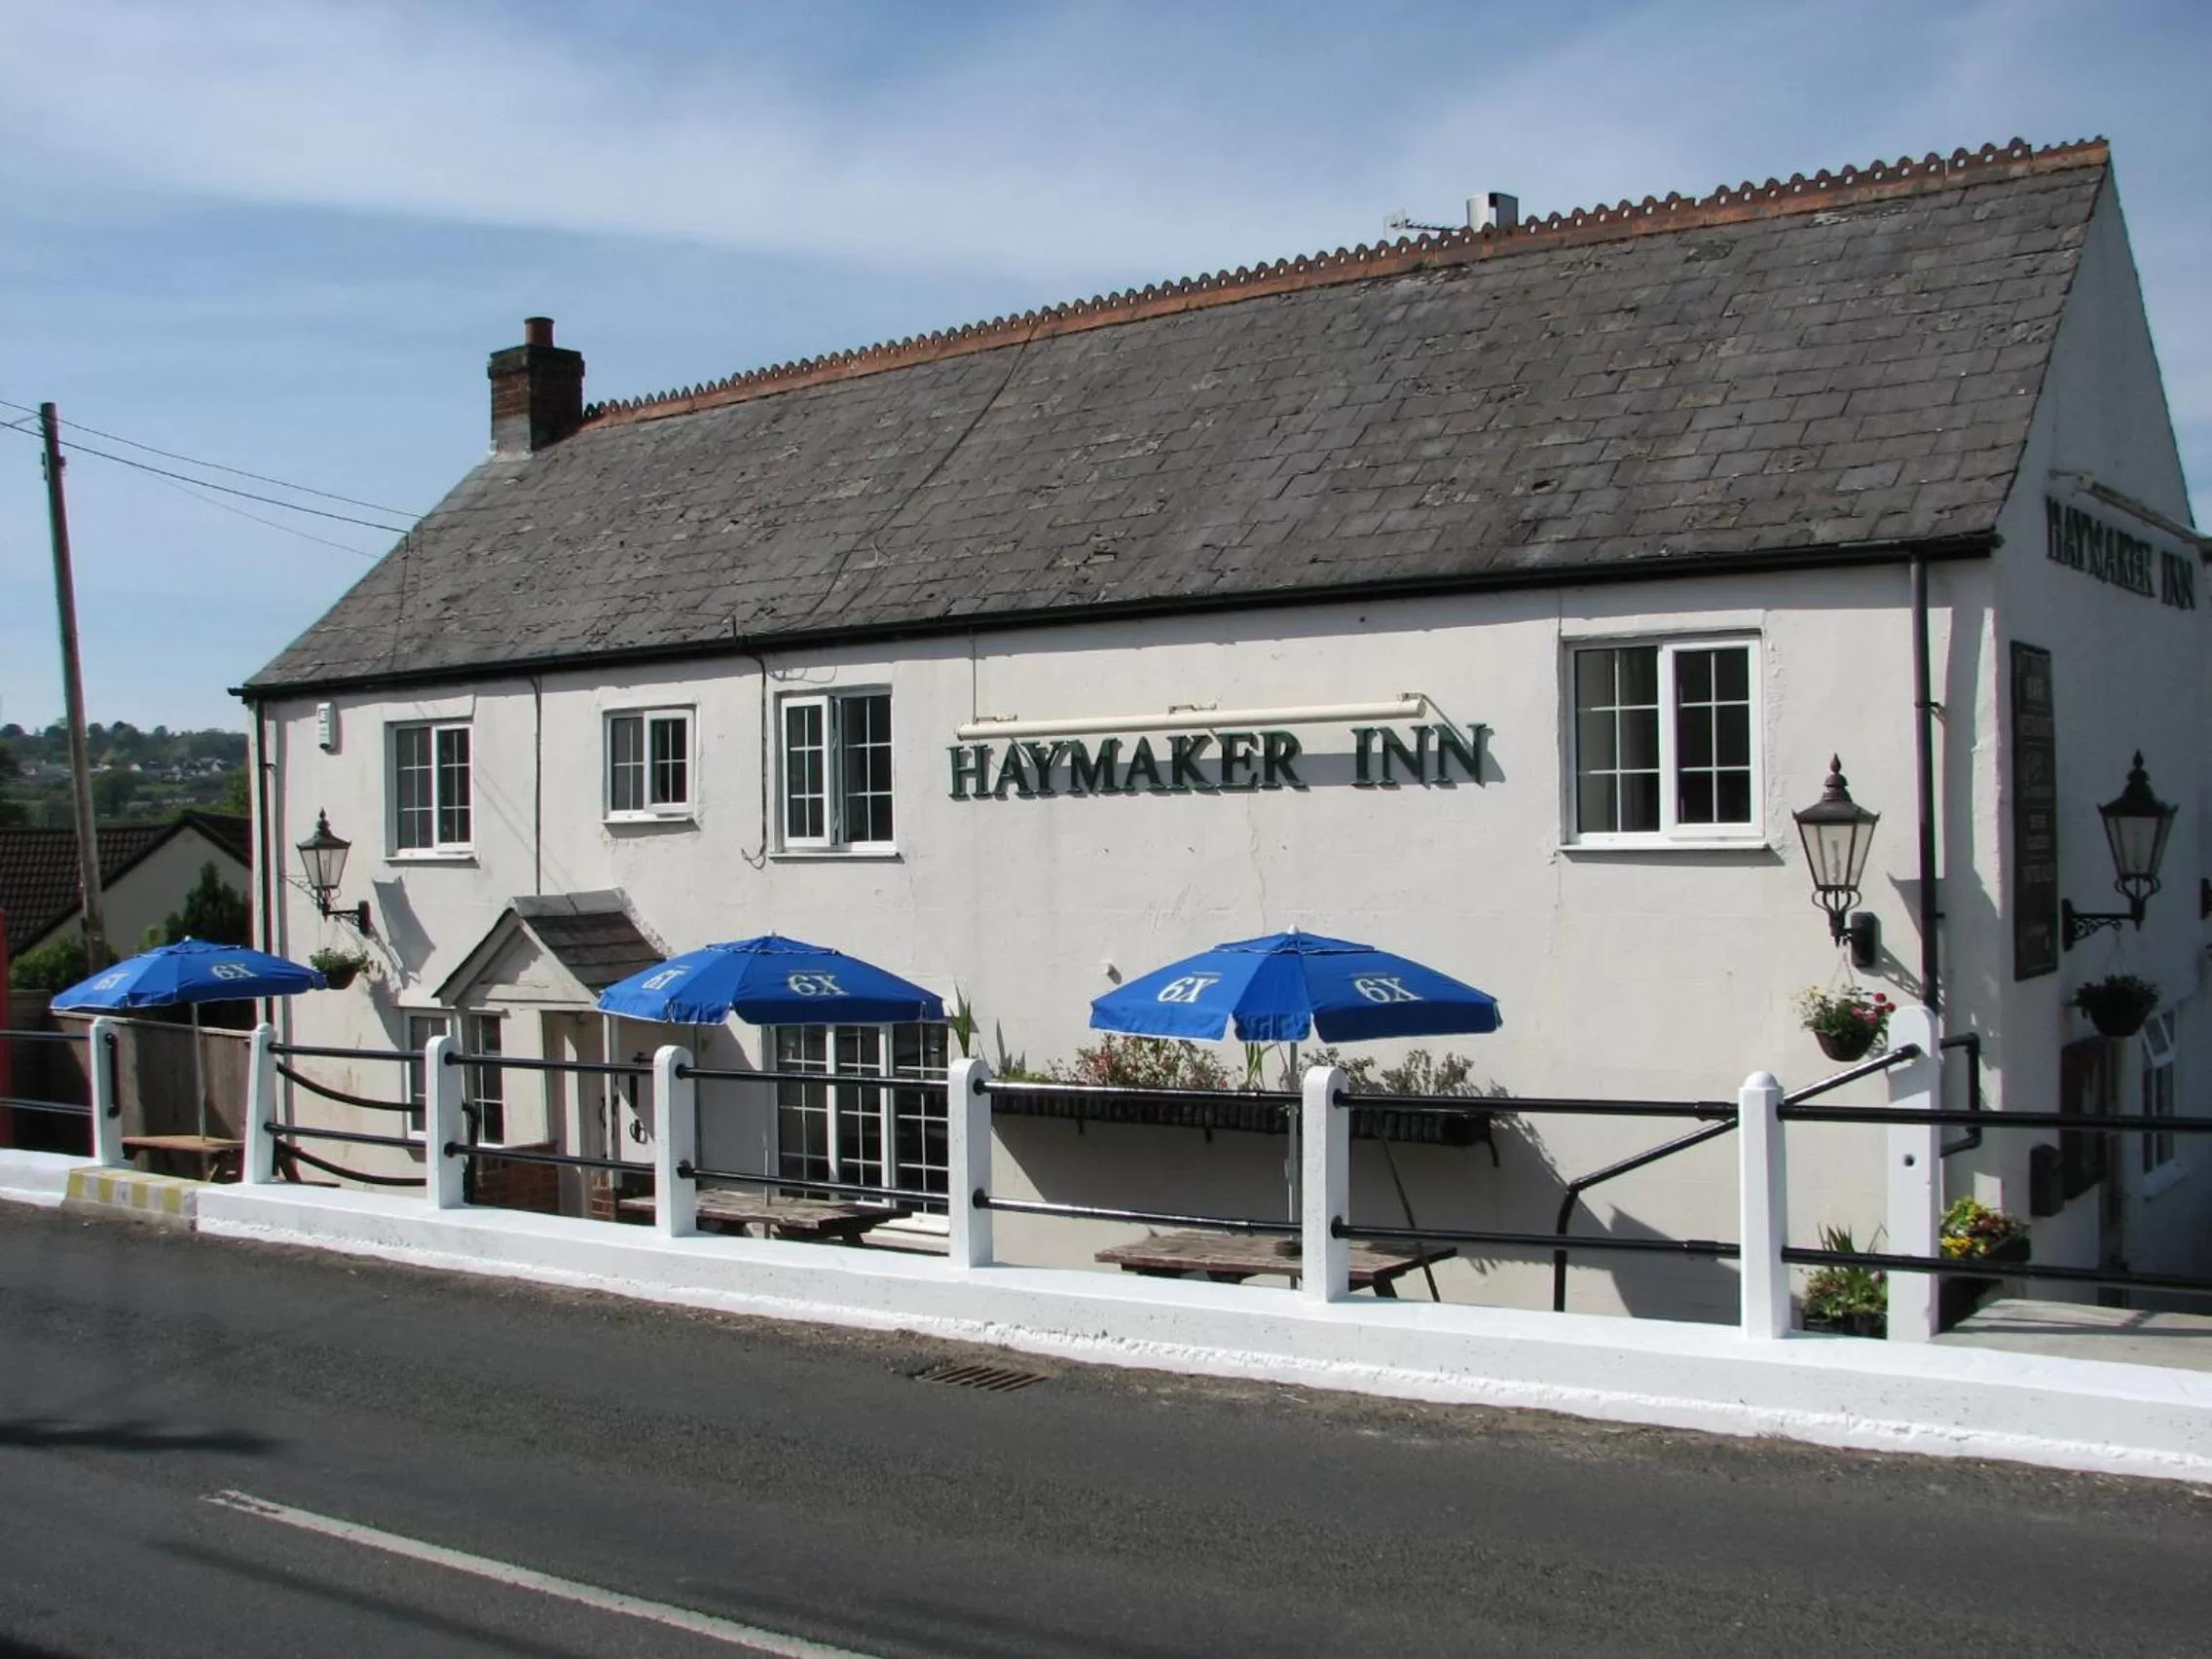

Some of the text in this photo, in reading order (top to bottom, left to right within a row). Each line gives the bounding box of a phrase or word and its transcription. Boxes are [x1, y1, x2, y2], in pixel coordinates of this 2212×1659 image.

[947, 722, 1489, 799] HAYMAKER INN
[788, 974, 849, 997] 6X
[1354, 977, 1424, 1004] 6X
